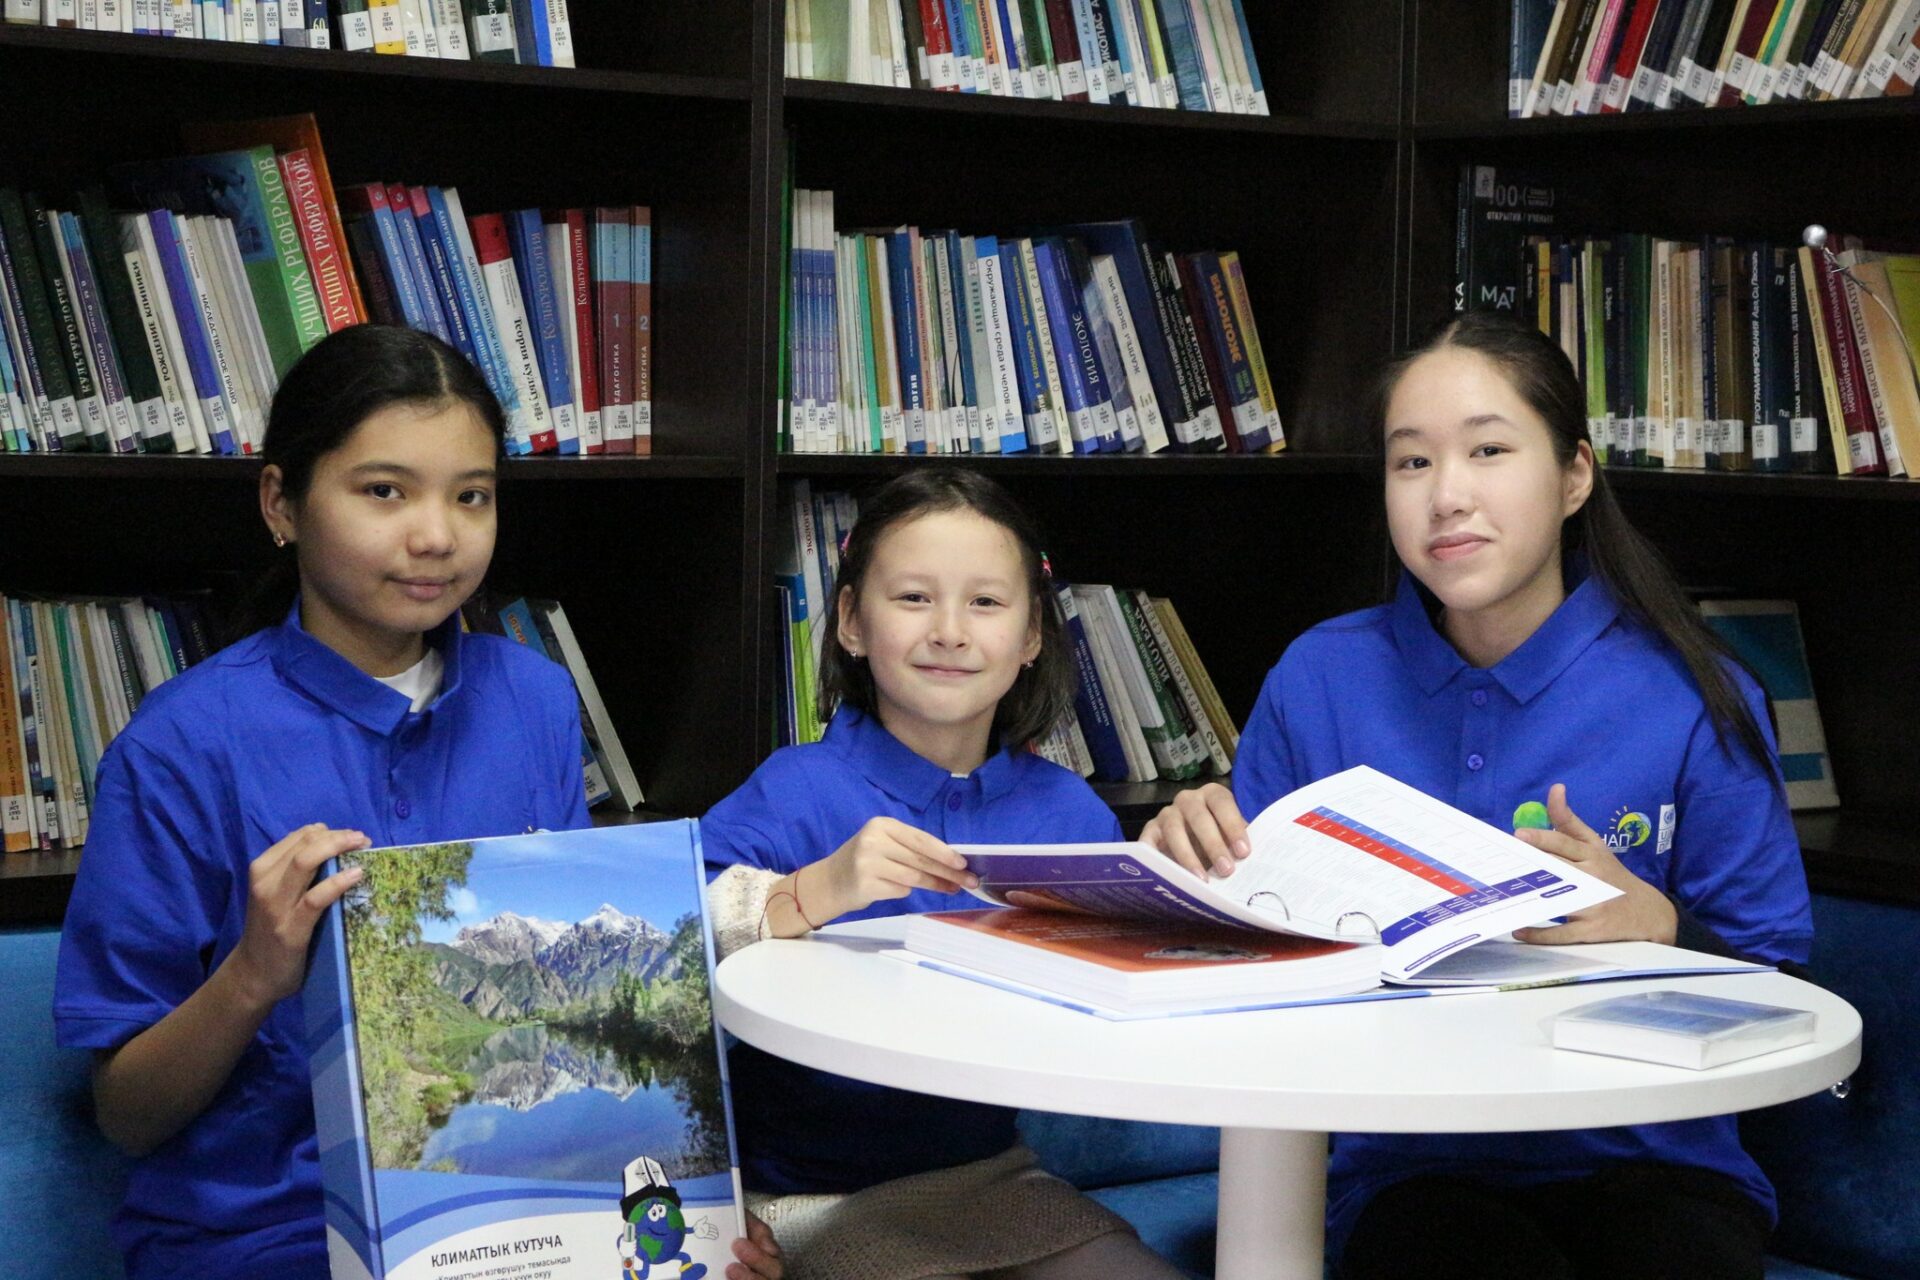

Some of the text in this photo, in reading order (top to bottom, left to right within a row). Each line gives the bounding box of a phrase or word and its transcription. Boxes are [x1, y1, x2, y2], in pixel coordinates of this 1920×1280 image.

[255, 154, 304, 268] РЕФЕРАТОВ
[289, 156, 330, 252] РЕФЕРАТОВ
[572, 227, 588, 305] Культурология
[983, 257, 1002, 330] Окружающая
[1454, 281, 1464, 310] КА
[52, 276, 93, 394] КУЛЬТУРОЛОГИЯ
[130, 259, 171, 382] РОЖДЕНИЕ КЛИНИКИ
[199, 292, 238, 405] НАСЛЕДСТВЕННОЕ ПРАВО
[613, 312, 620, 327] 1
[640, 315, 649, 330] 2
[992, 330, 1006, 362] среда
[1023, 244, 1061, 393] ОКРУЖАЮЩАЯ СРЕДА
[1070, 310, 1100, 385] ЭКОЛОГИЯ
[1207, 272, 1242, 363] ЭКОЛОГИЯ
[1791, 313, 1799, 331] ДЛЯ
[999, 372, 1012, 405] челов
[1752, 319, 1762, 424] ПРОГРАММИРОВАНИЯ
[1792, 332, 1800, 391] МАТЕМАТИКА
[1861, 347, 1881, 398] ВЫСШЕЙ
[1122, 602, 1163, 693] СОЦИАЛЬНАЯ ЭКОЛОГИЯ
[1139, 596, 1205, 722] ОКРУЖАЮЩАЯ СРЕДА
[1206, 731, 1217, 746] 2
[431, 1235, 563, 1268] КЛИМАТТЫК КУТУЧА
[527, 1256, 571, 1271] темасында
